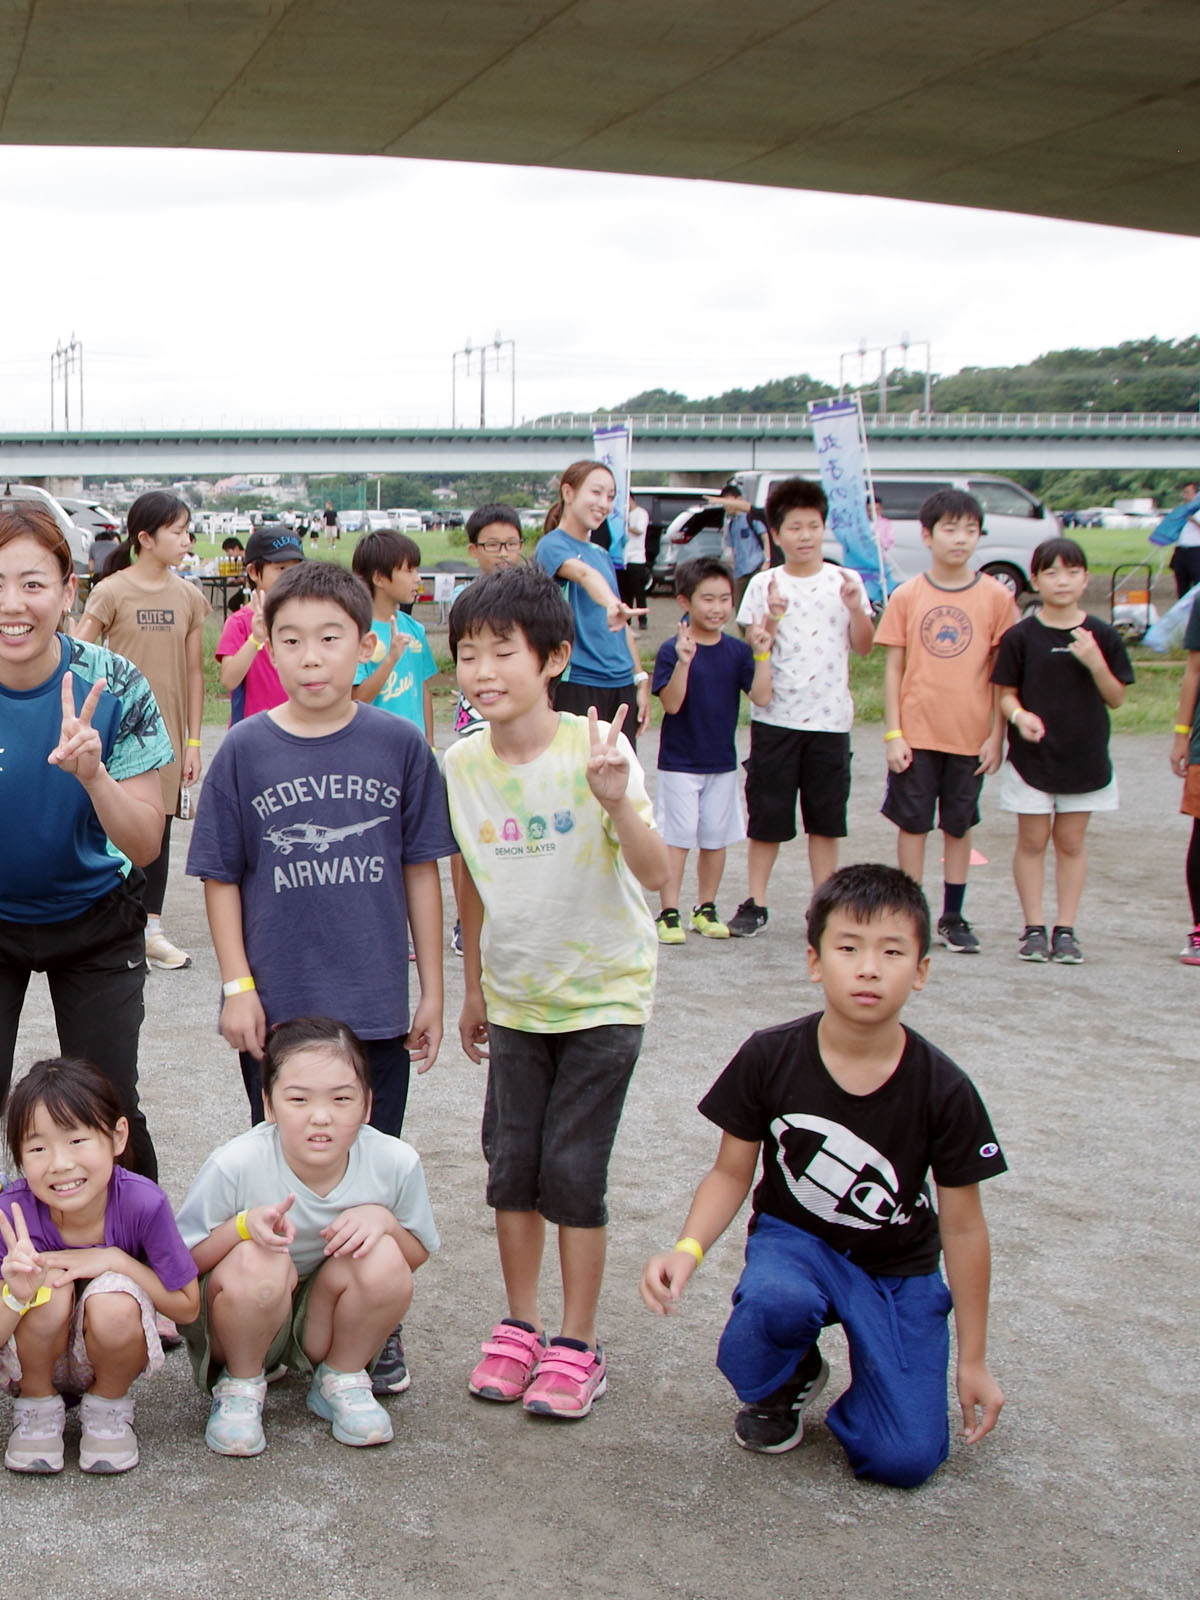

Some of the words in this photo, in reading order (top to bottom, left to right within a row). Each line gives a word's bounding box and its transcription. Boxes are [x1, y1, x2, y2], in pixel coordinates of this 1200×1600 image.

[139, 611, 164, 624] CUTE
[251, 774, 401, 821] REDEVERS'S
[495, 847, 524, 856] DEMON
[526, 843, 556, 854] SLAYER
[274, 856, 385, 893] AIRWAYS
